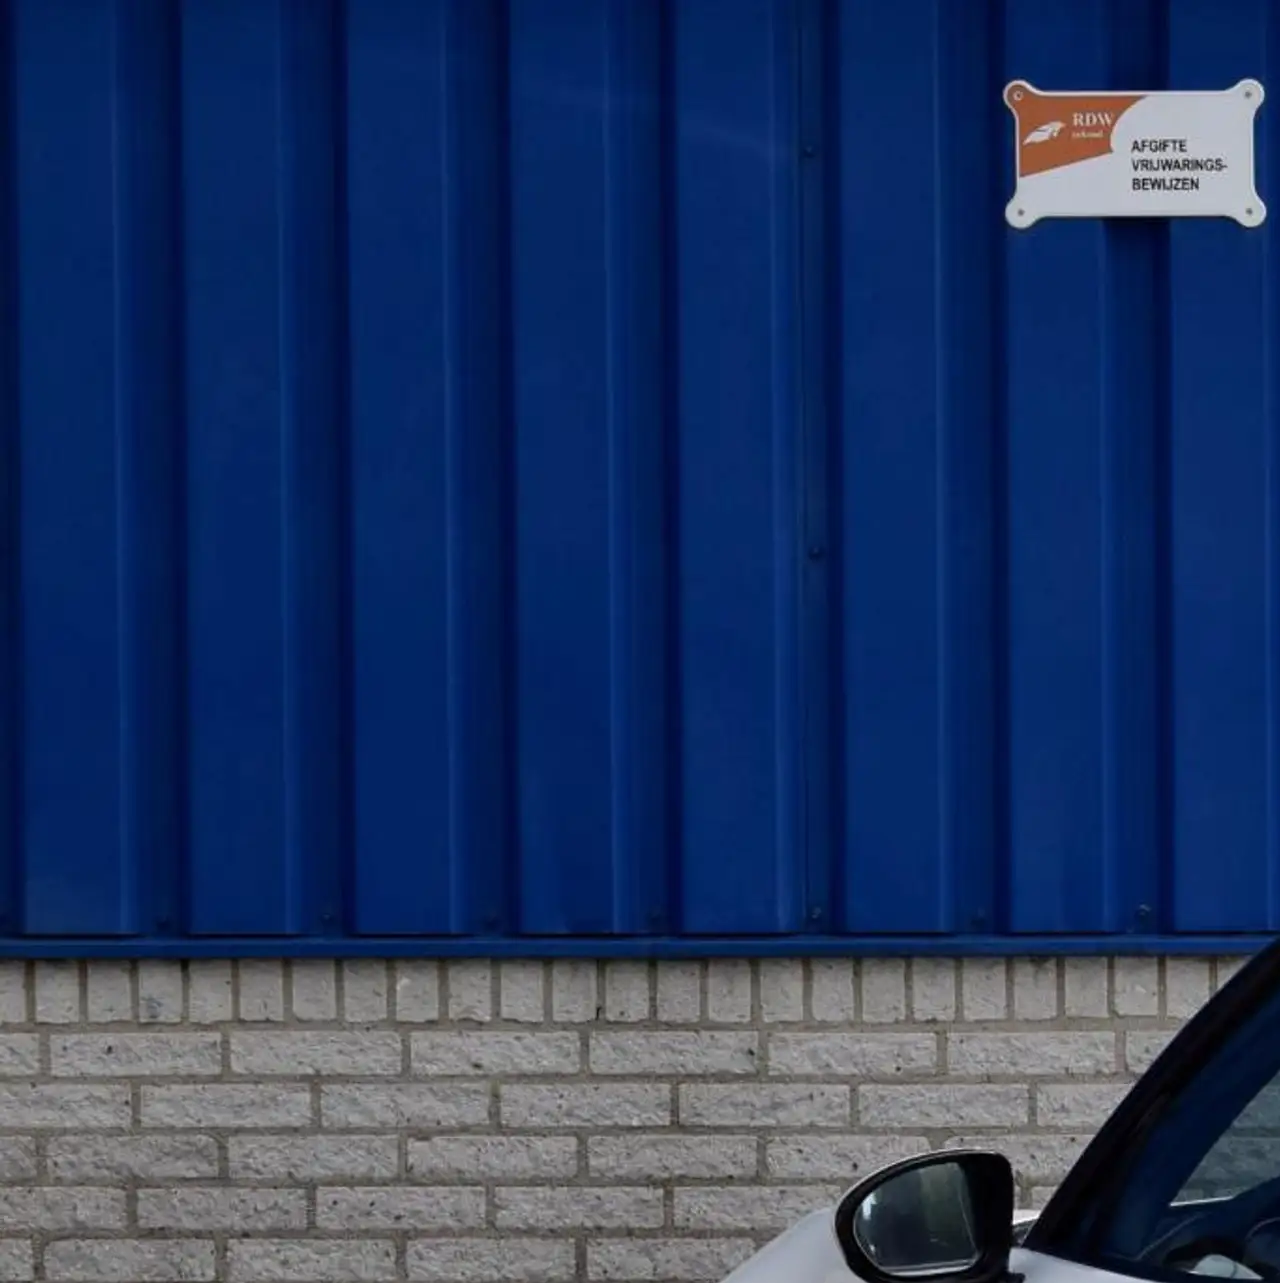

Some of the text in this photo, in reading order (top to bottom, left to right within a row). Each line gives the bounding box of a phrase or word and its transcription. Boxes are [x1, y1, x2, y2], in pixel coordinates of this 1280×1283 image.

[1072, 111, 1115, 127] RDW
[1131, 139, 1188, 153] AFGIFTE
[1131, 158, 1228, 172] VRIJWARINGS-
[1131, 177, 1200, 191] BEWIJZEN
